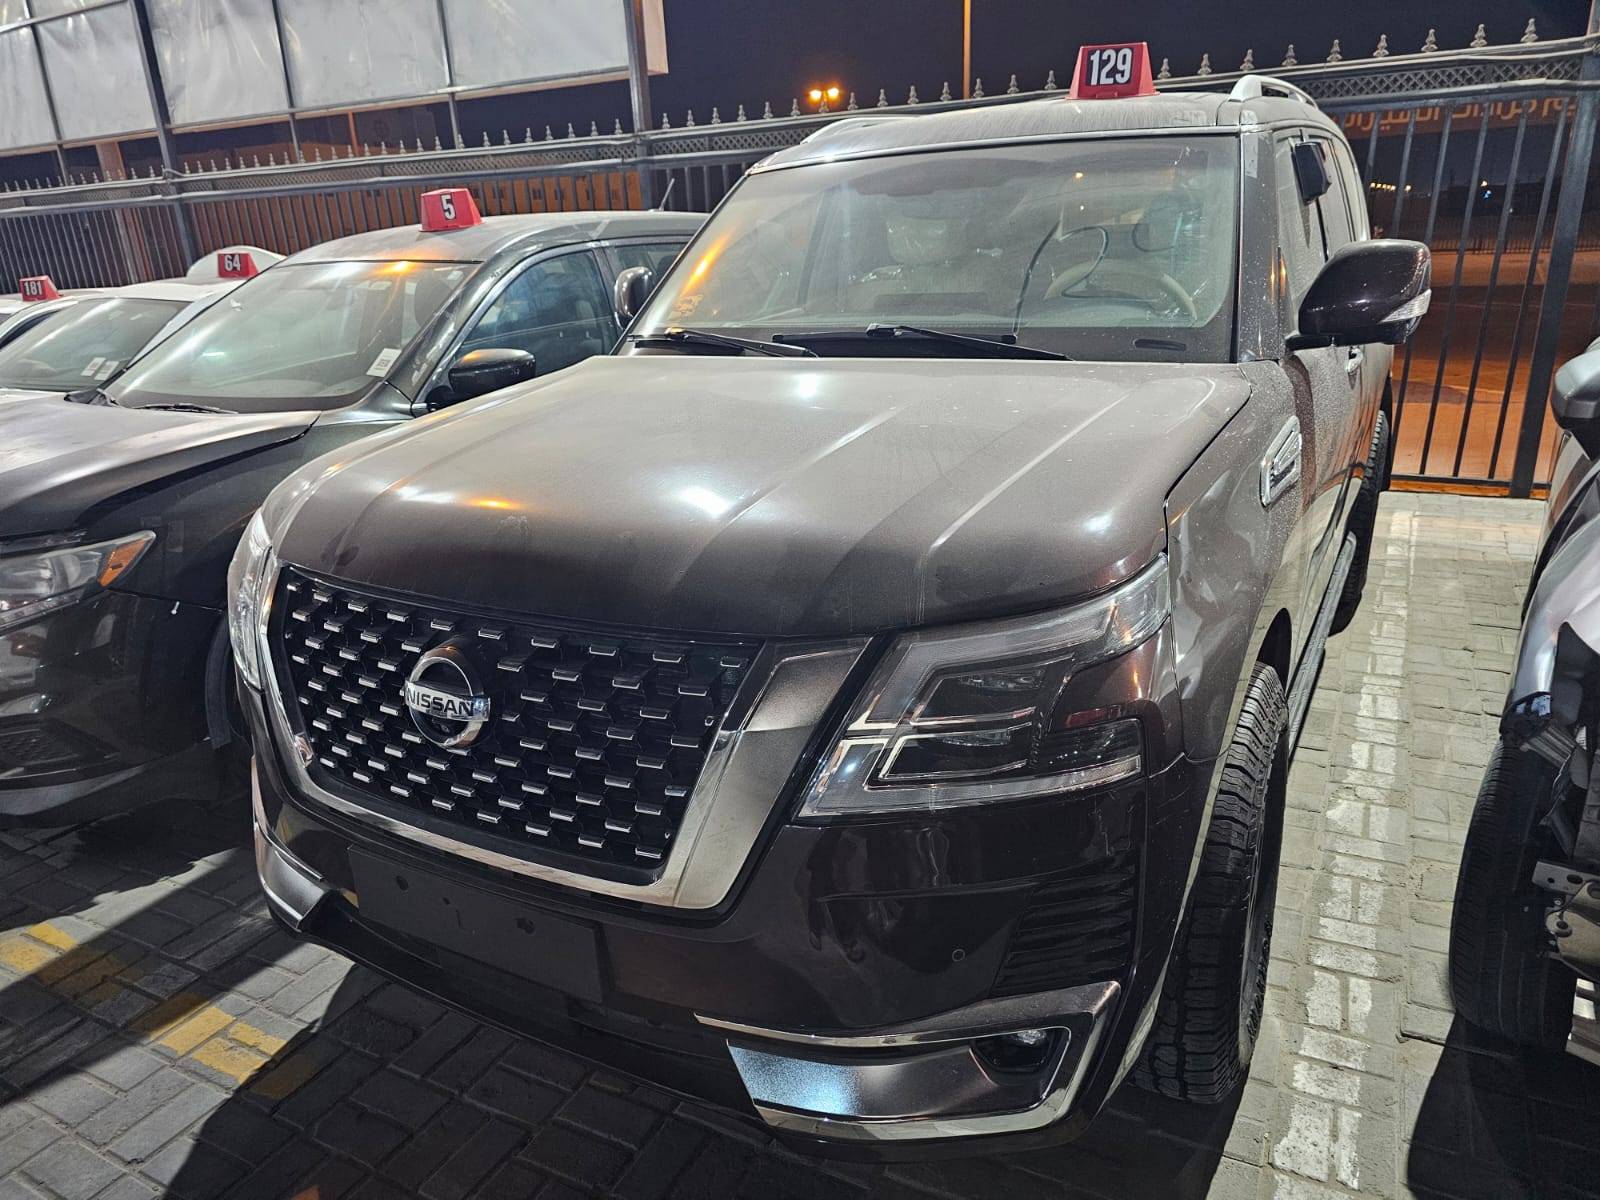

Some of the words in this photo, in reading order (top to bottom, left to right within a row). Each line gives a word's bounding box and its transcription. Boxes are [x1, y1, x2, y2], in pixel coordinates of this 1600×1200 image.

[1090, 47, 1133, 86] 129
[441, 194, 456, 220] 5
[224, 254, 241, 272] 64
[24, 280, 43, 296] 181
[406, 687, 474, 717] NISSAN
